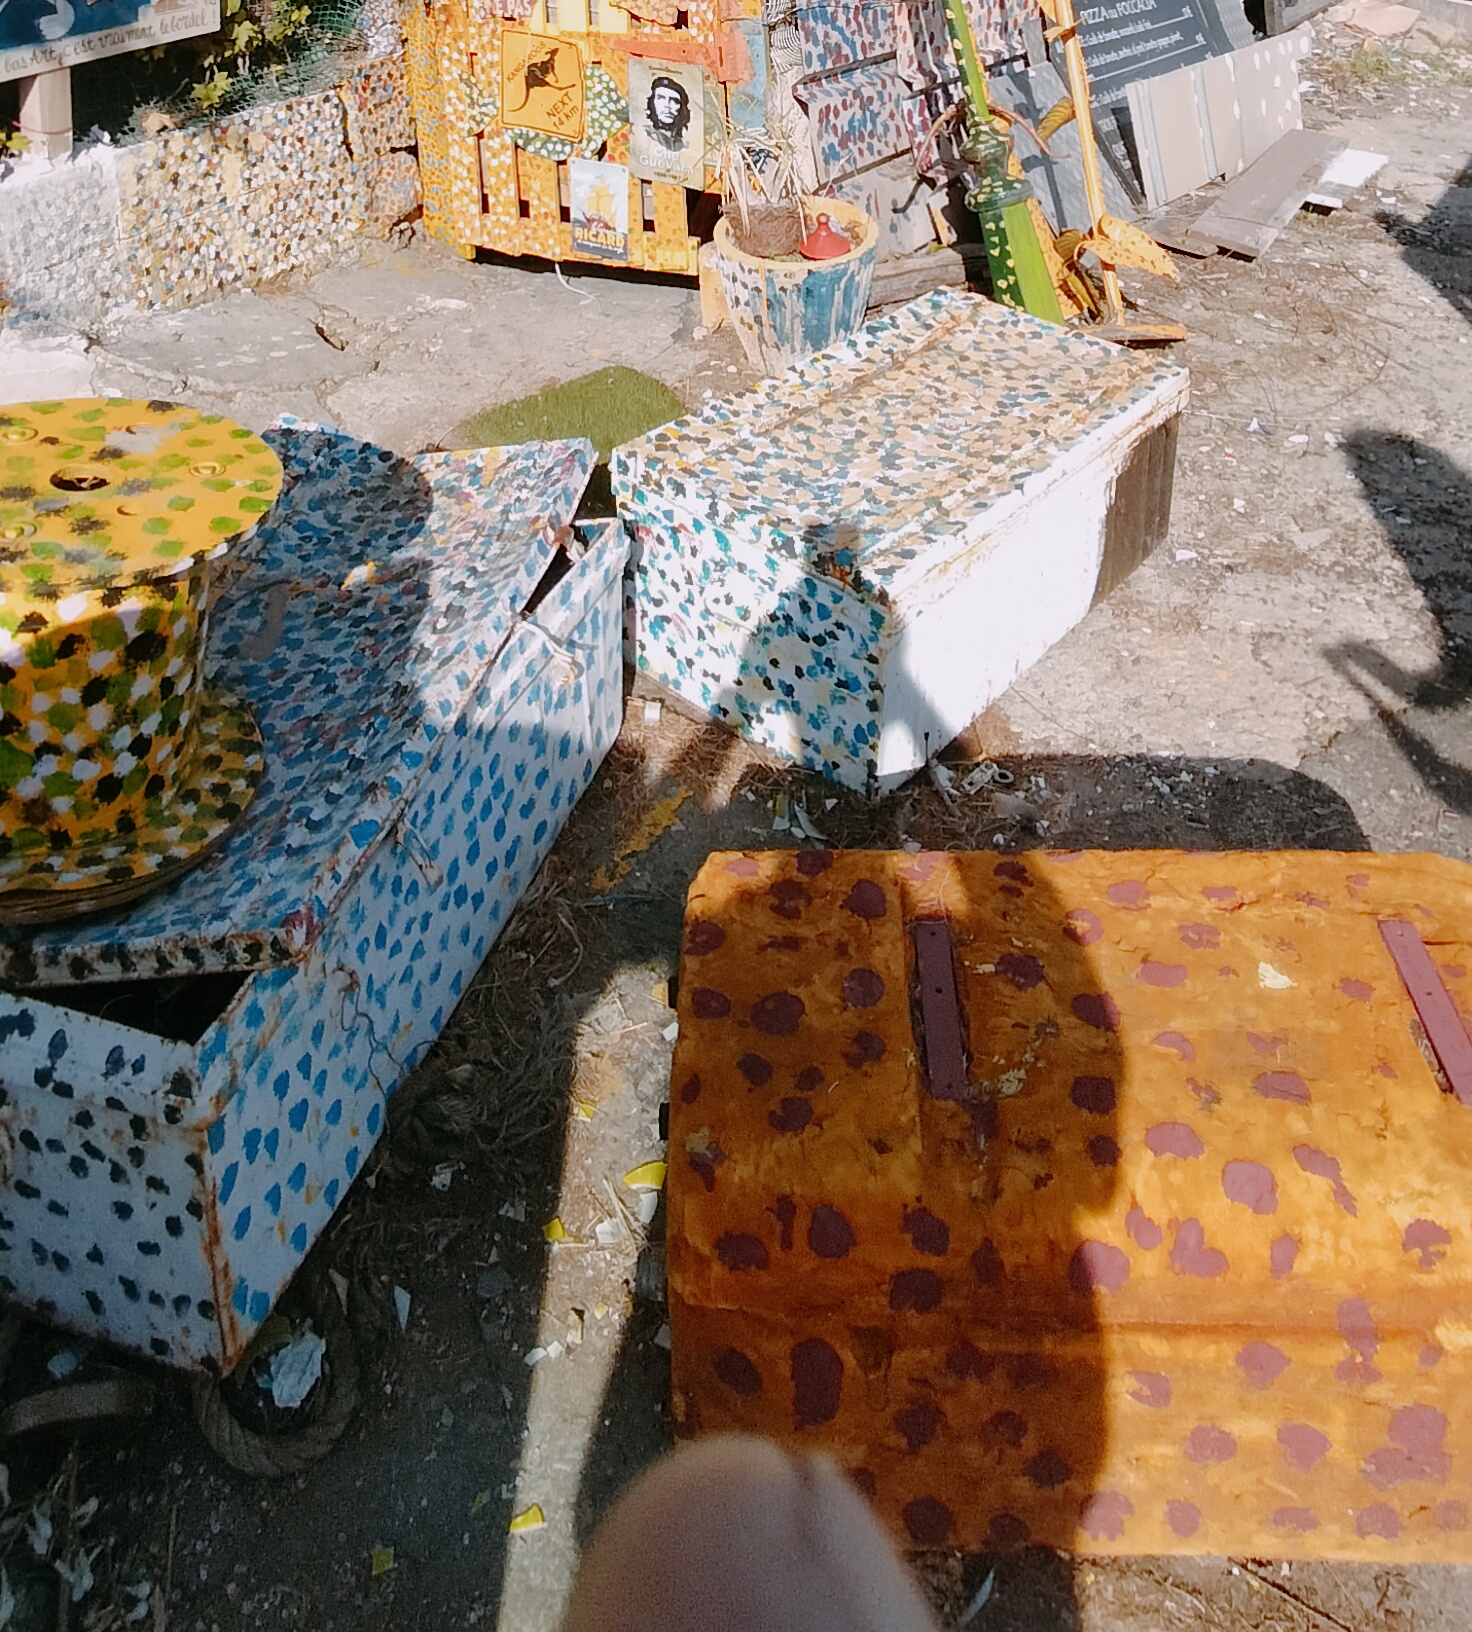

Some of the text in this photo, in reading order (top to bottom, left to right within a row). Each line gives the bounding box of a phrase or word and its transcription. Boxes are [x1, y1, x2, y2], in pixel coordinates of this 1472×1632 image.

[546, 91, 574, 119] NEXT
[552, 104, 580, 131] 14 km
[574, 226, 625, 249] RICARD
